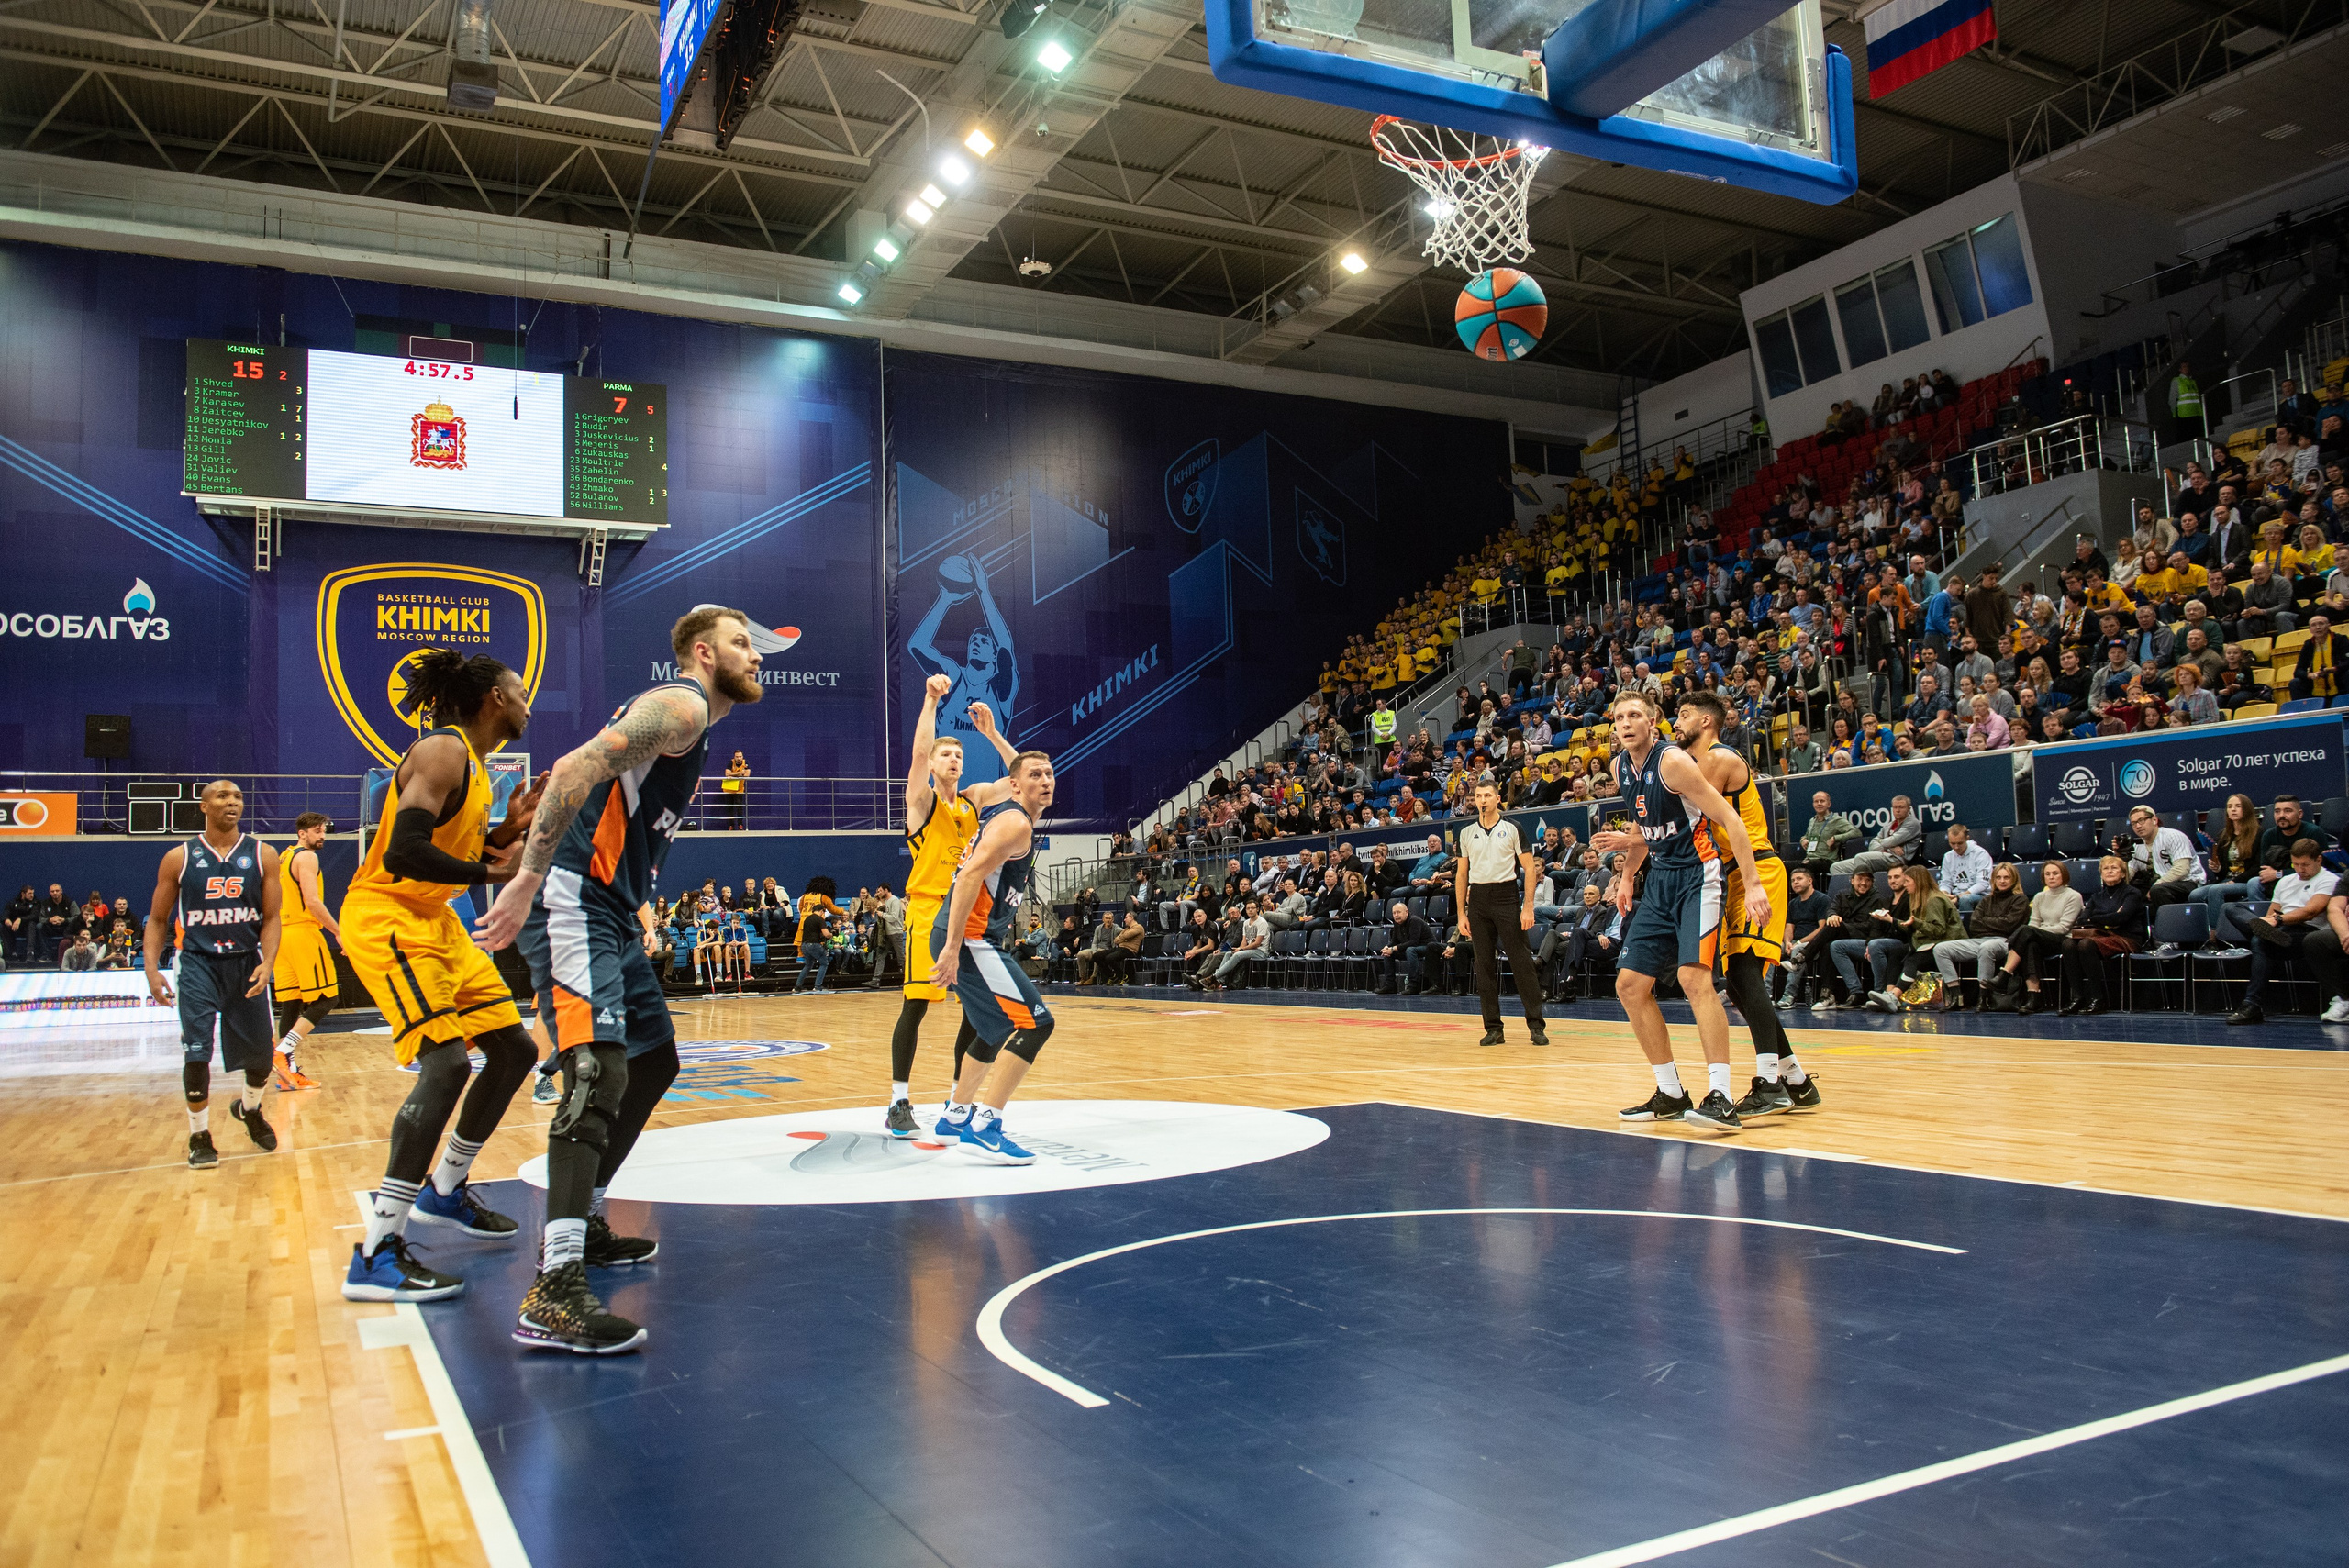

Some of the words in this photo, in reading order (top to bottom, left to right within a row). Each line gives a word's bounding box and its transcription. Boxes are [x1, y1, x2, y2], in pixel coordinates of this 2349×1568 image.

[227, 345, 264, 356] KHIMKI
[233, 361, 264, 379] 15
[280, 370, 287, 380] 2
[404, 361, 473, 381] 4:57.5
[203, 378, 234, 387] Shved
[295, 386, 302, 395] 3
[203, 388, 239, 397] Kramer
[604, 383, 632, 392] PARMA
[202, 397, 245, 407] Karasev
[281, 404, 286, 412] 1
[295, 405, 302, 413] 7
[614, 396, 628, 413] 7
[647, 406, 654, 415] 5
[202, 407, 245, 417] Zaitcev
[202, 417, 269, 429] Desyatnikov
[582, 414, 629, 424] Grigoryev
[582, 422, 608, 430] Budin
[202, 427, 245, 437] Jerebko
[280, 432, 286, 440] 1
[295, 433, 302, 441] 2
[583, 431, 639, 442] Juskevicius
[202, 436, 232, 445] Monia
[583, 439, 618, 450] Mejeris
[202, 445, 226, 454] Gill
[583, 449, 629, 459] Zukauskas
[202, 454, 231, 464] Jovic
[583, 458, 624, 467] Moultrie
[201, 464, 238, 474] Valiev
[583, 466, 618, 475] Zabelin
[1174, 450, 1211, 486] KHIMKI
[201, 474, 231, 484] Evans
[583, 475, 634, 485] Bondarenko
[201, 484, 243, 494] Bertans
[583, 484, 614, 493] Zhmako
[583, 494, 618, 502] Bulanov
[583, 502, 624, 511] Williams
[377, 593, 456, 605] BASKETBALL
[460, 596, 490, 606] CLUB
[376, 605, 490, 633] KHIMKI
[377, 631, 436, 642] MOSCOW
[442, 633, 490, 644] REGION
[650, 661, 840, 686] Меинвест
[1072, 643, 1159, 726] KHIMKI
[954, 716, 979, 732] Хим
[2177, 758, 2221, 775] Solgar
[2224, 754, 2242, 769] 70
[2244, 753, 2270, 767] лет
[2273, 749, 2326, 768] успеха
[2058, 778, 2100, 791] SOLGAR
[2127, 769, 2149, 789] 70
[2179, 780, 2188, 791] в
[2190, 776, 2232, 791] мире.
[2048, 796, 2066, 806] Since
[2094, 793, 2110, 802] 1947
[1635, 795, 1648, 817] 5
[1834, 802, 1955, 828] ОСОГАЗ
[205, 877, 245, 899] 56
[187, 906, 261, 927] PARMA
